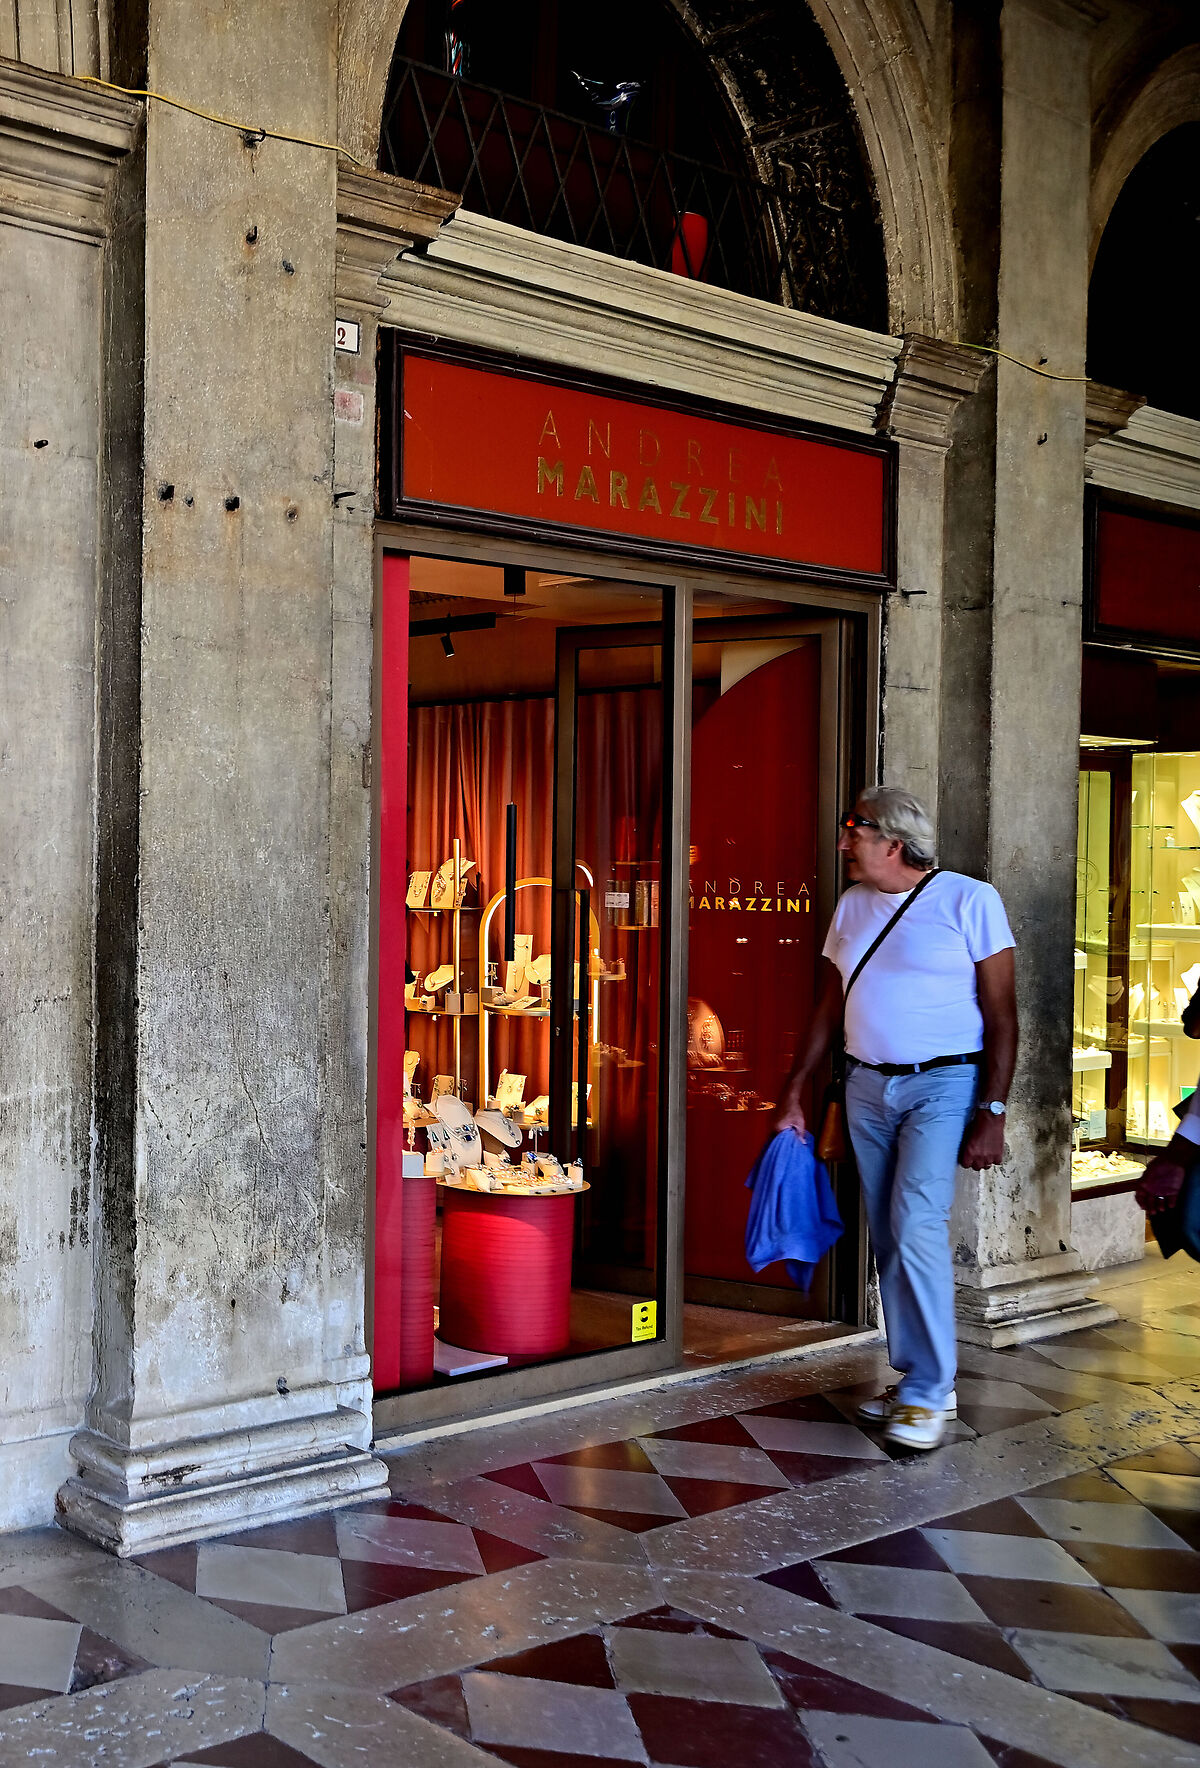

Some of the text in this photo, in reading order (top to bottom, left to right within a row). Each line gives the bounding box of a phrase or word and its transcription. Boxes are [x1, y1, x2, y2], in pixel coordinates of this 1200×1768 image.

[337, 327, 346, 346] 2
[538, 409, 783, 491] ANDREA
[537, 456, 783, 536] MARAZZINI
